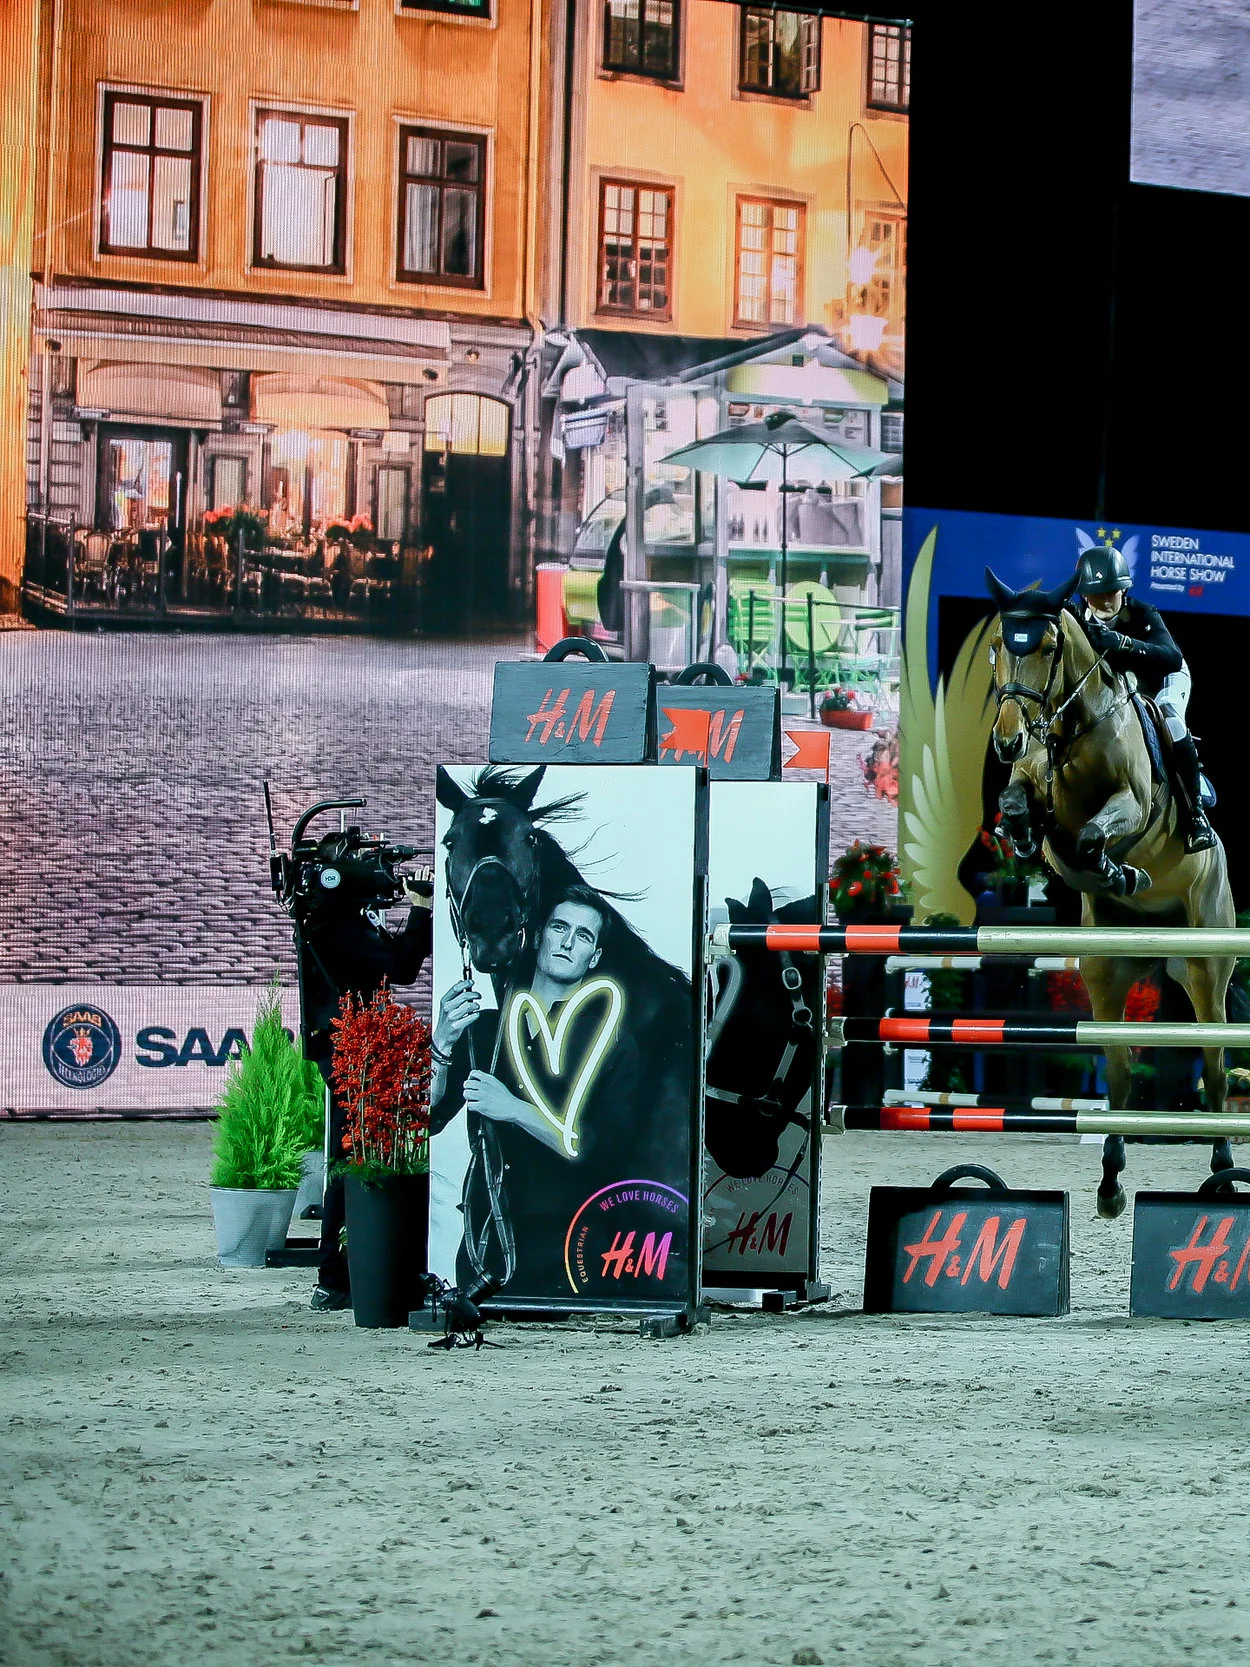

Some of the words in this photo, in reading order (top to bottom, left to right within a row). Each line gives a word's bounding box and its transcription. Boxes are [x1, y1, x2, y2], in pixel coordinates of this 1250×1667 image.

[1150, 551, 1235, 567] INTERNATIONAL
[1151, 534, 1199, 549] SWEDEN
[1150, 566, 1187, 580] HORSE
[1189, 568, 1226, 583] SHOW
[525, 688, 616, 747] H&M
[62, 1011, 102, 1028] SAAB
[600, 1196, 616, 1212] WE
[616, 1189, 640, 1204] LOVE
[643, 1190, 680, 1214] HORSES
[727, 1211, 793, 1257] H&M
[903, 1210, 1027, 1290] H&M
[576, 1226, 589, 1283] EQUESTRIAN
[601, 1231, 673, 1280] H&M
